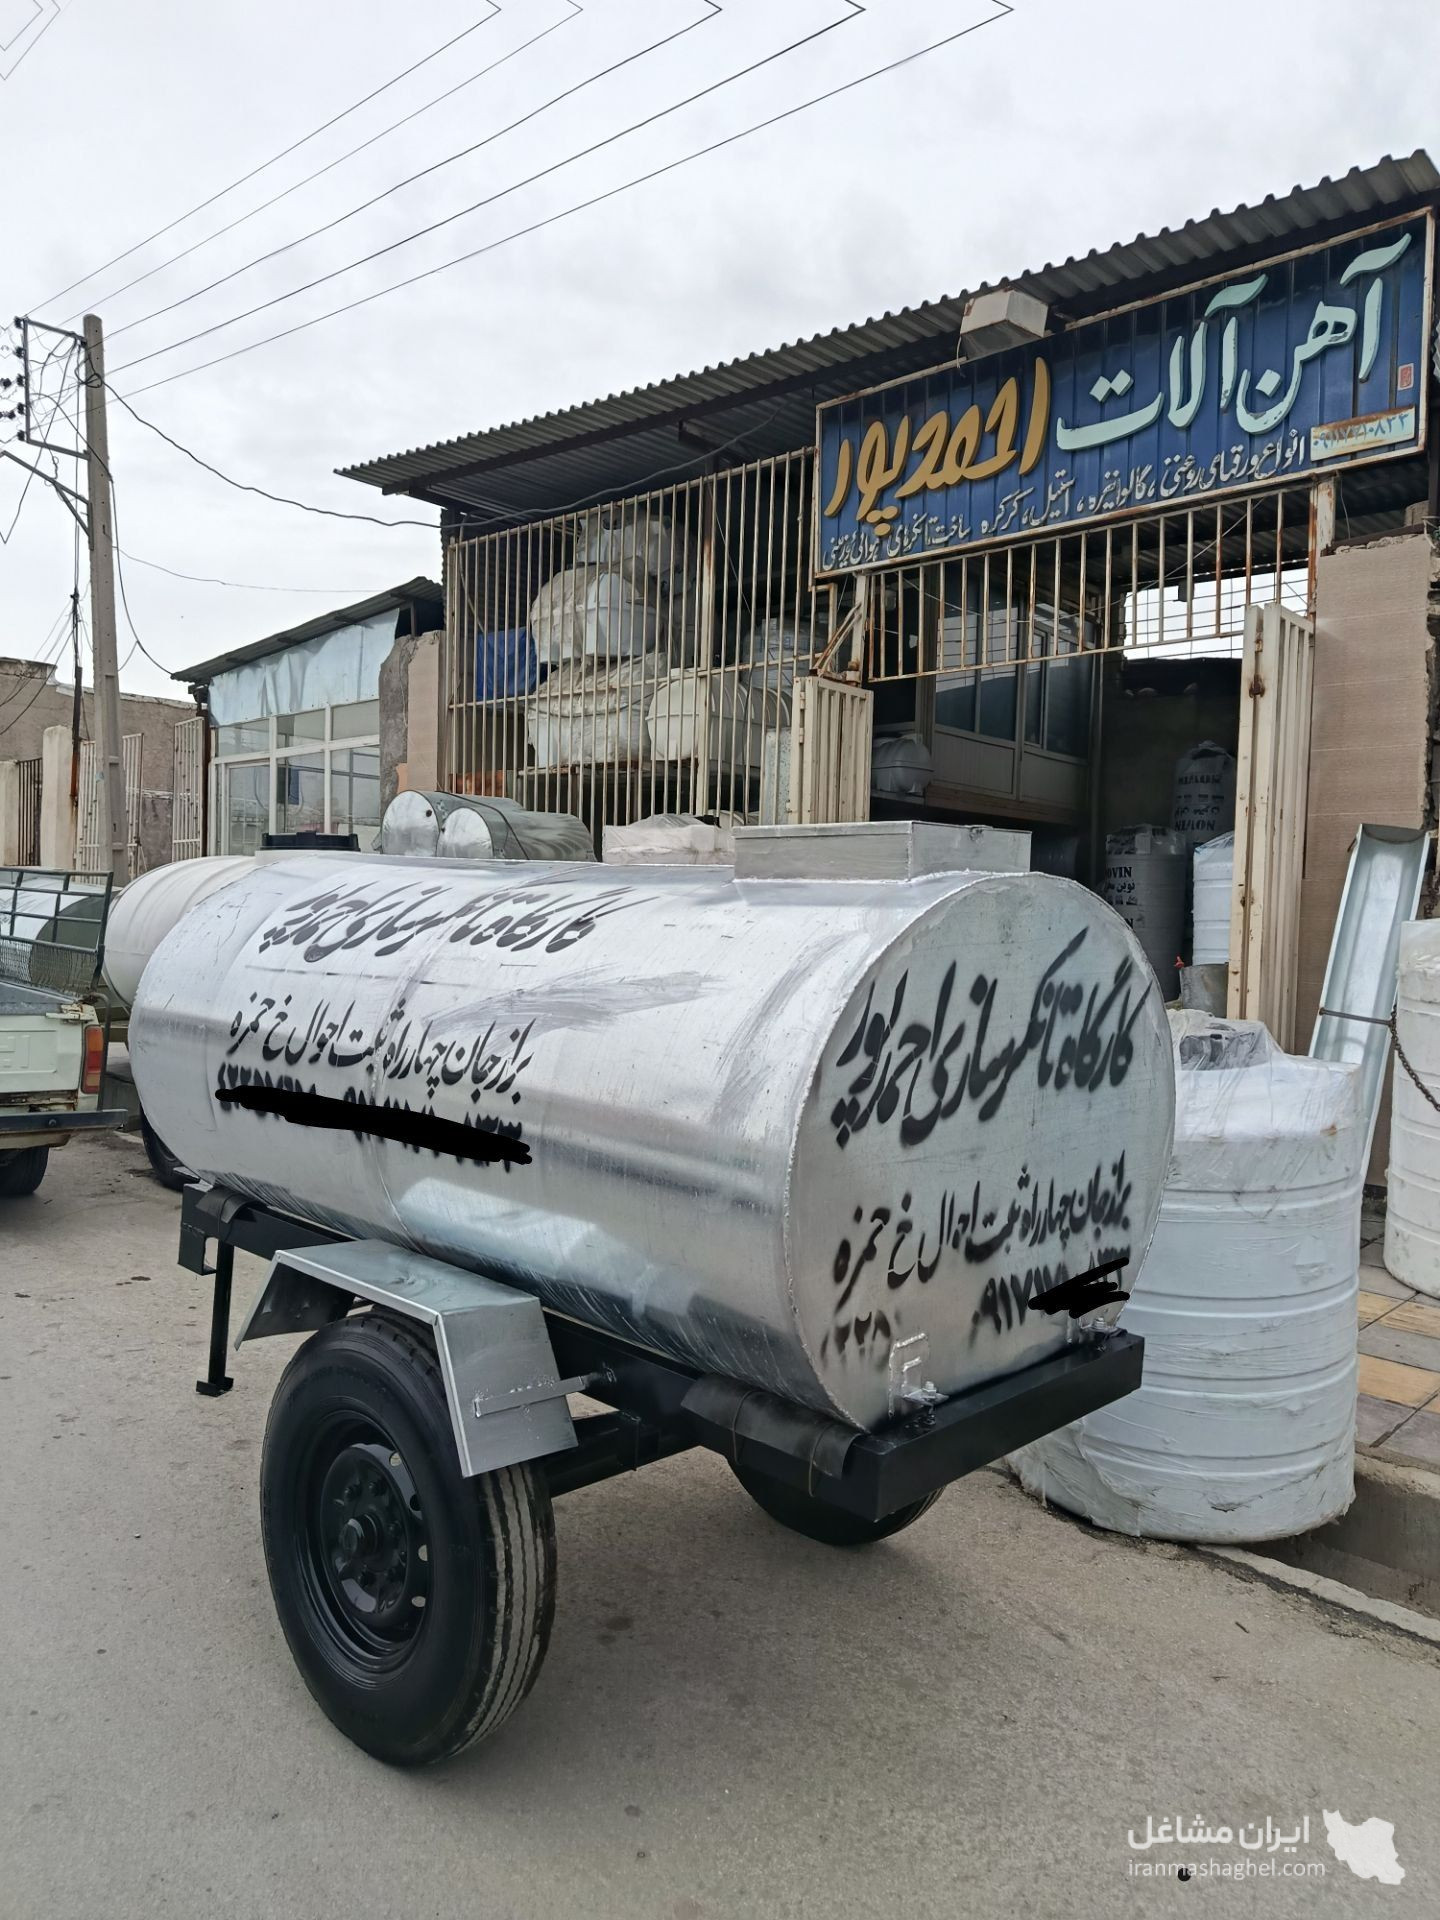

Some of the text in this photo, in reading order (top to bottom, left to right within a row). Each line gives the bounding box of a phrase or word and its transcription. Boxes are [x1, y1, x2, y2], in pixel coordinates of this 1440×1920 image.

[1056, 273, 1269, 452] آلات
[1235, 232, 1411, 435] آهن
[981, 487, 1035, 534] کرکره
[1253, 429, 1305, 480] انواع
